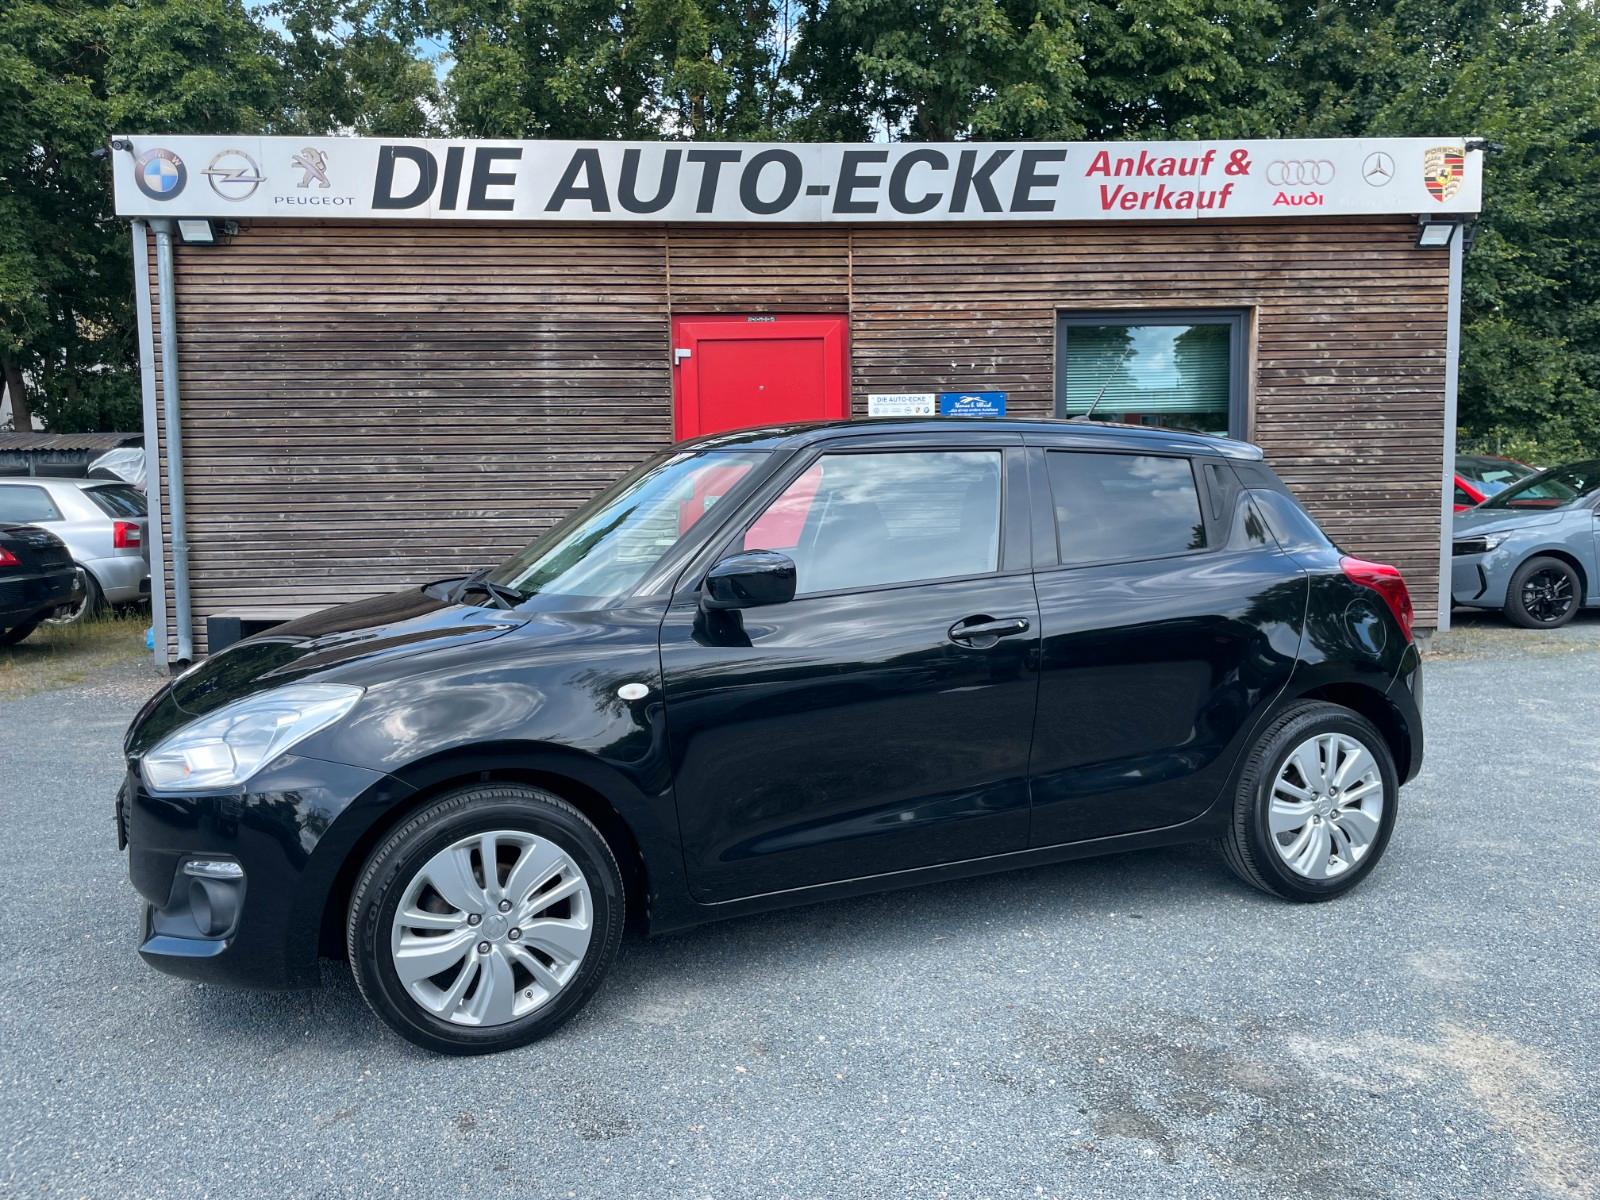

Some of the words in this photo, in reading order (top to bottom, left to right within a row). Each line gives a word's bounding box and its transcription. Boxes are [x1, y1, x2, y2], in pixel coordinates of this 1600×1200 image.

[1085, 149, 1217, 177] Ankauf
[1224, 149, 1252, 176] &
[371, 145, 523, 212] DIE
[543, 148, 1068, 215] AUTO-ECKE
[274, 196, 356, 206] PEUGEOT
[1099, 183, 1234, 211] Verkauf
[1272, 191, 1324, 206] Audi
